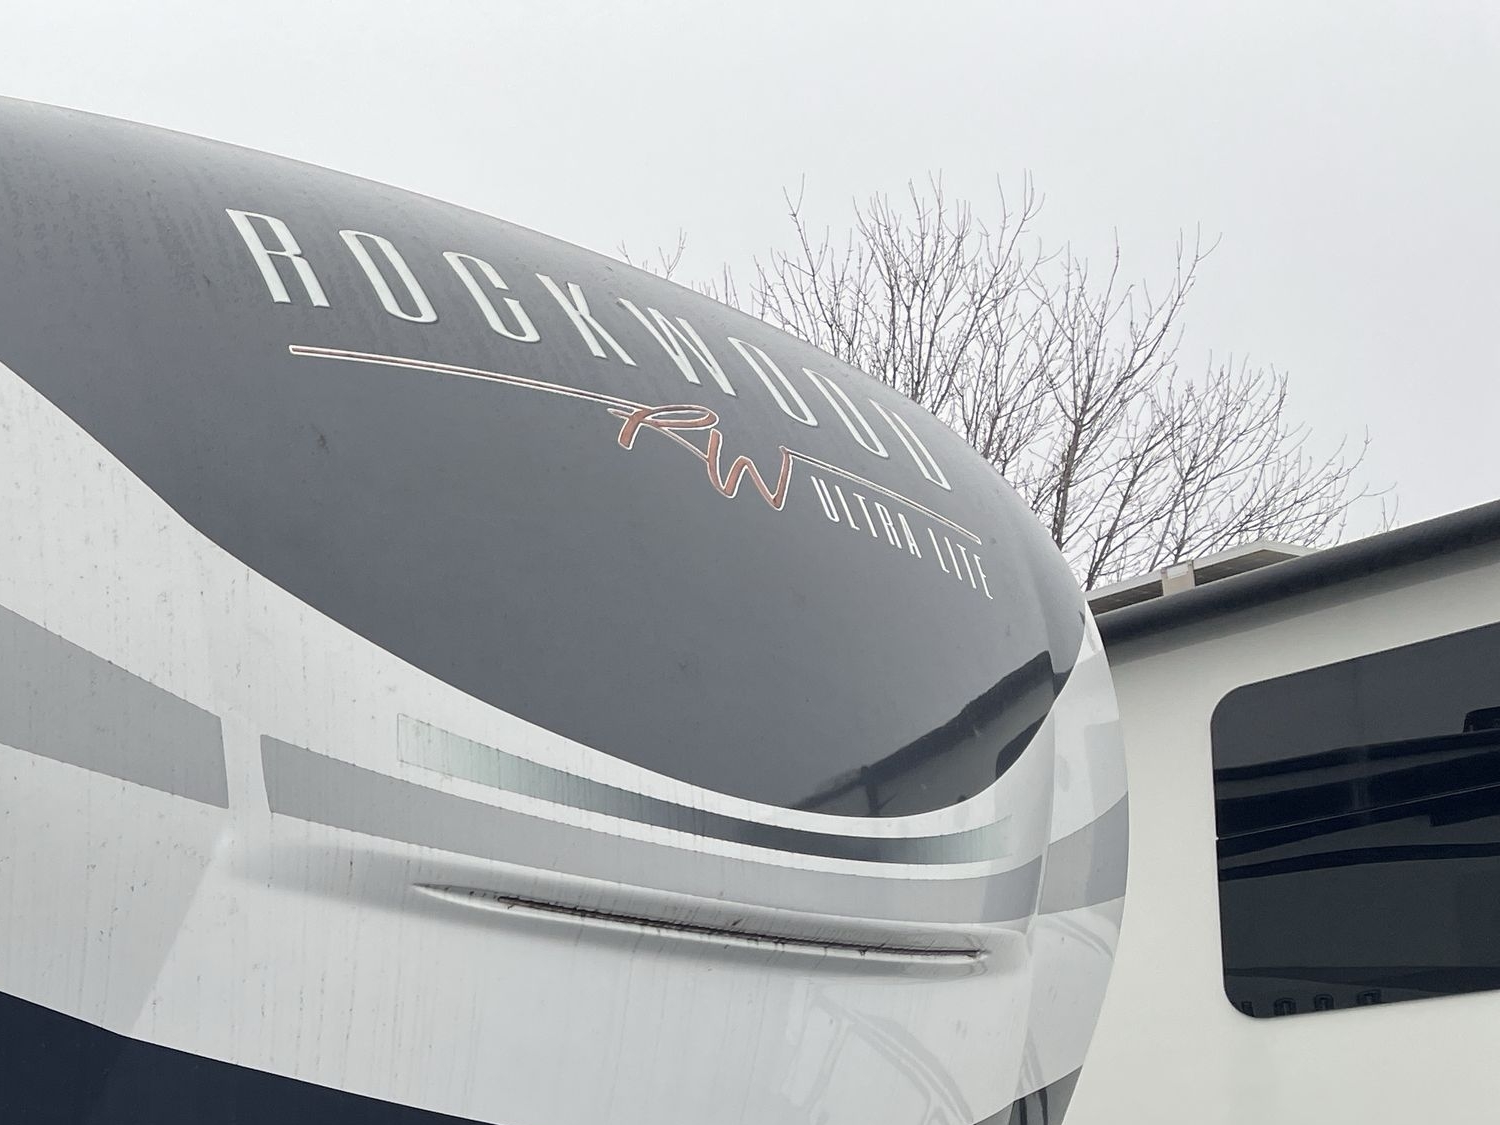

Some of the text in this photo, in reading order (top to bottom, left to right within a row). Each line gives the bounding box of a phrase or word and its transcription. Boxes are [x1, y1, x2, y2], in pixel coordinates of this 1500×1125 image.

[225, 208, 953, 492] ROCKWOOD
[809, 475, 994, 600] ULTRA LITE
